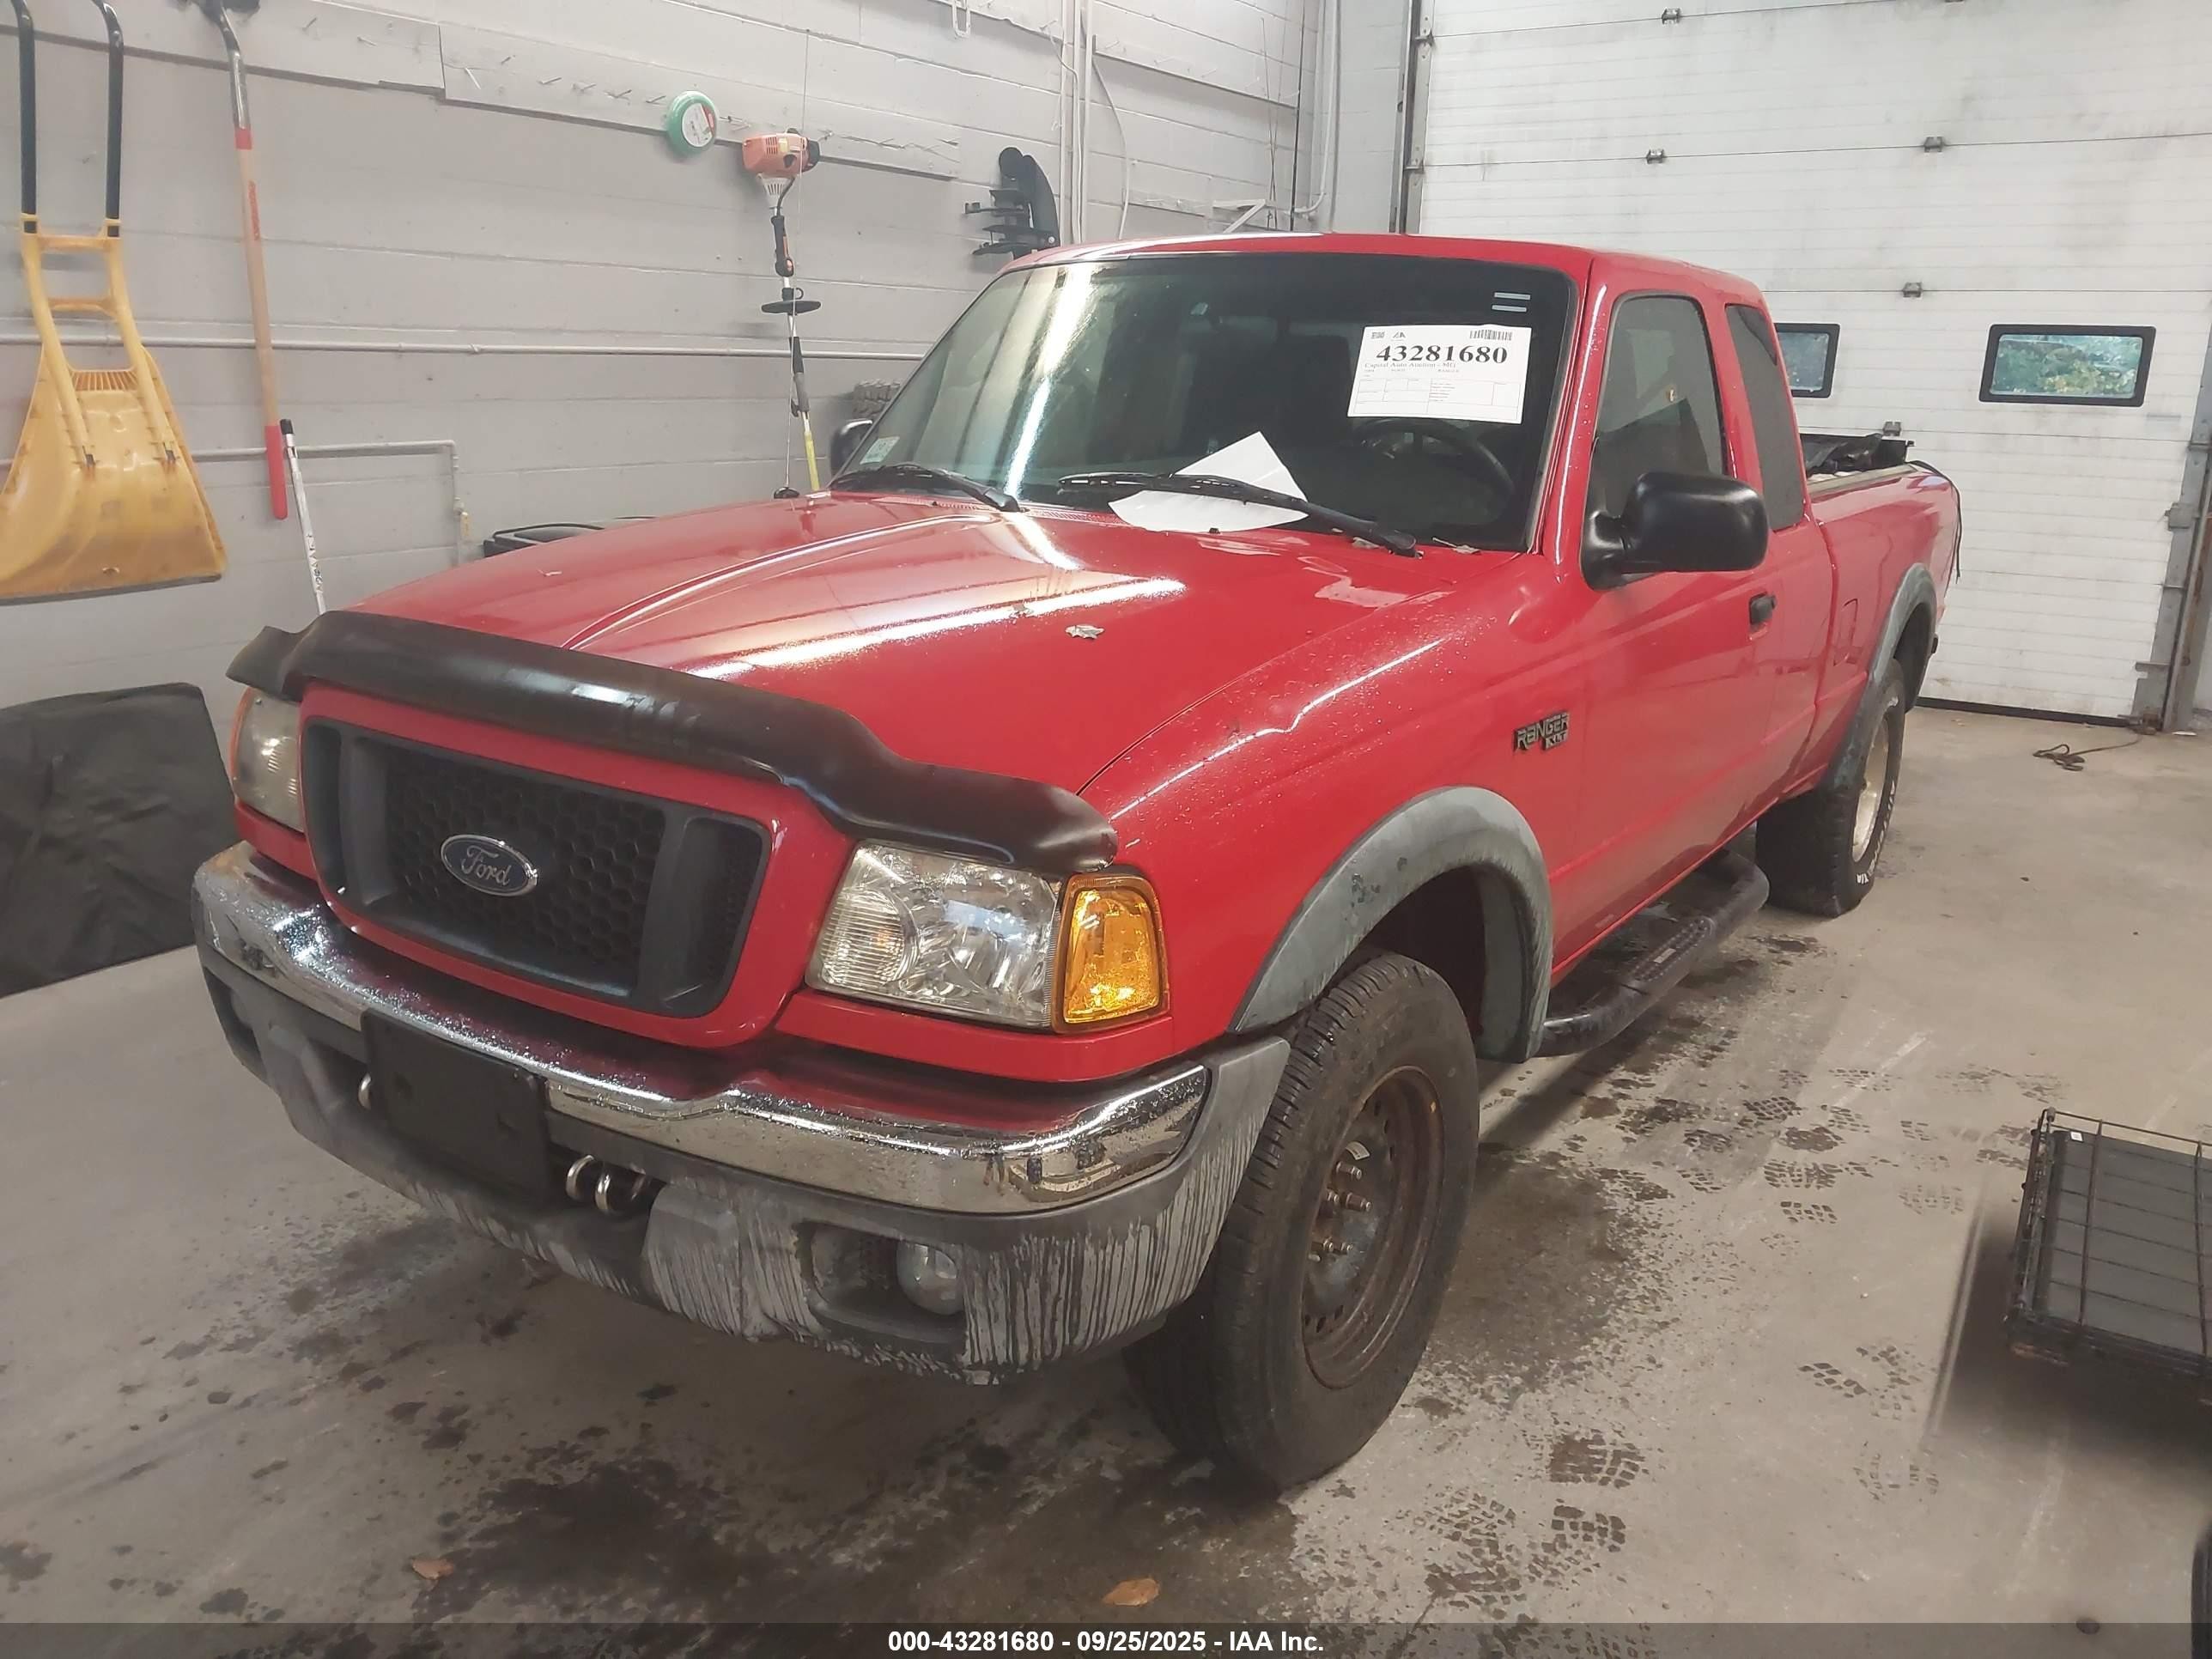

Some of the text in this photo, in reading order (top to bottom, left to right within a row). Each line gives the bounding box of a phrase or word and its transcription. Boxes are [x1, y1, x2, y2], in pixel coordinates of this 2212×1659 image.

[1376, 344, 1508, 364] 43281680
[1514, 711, 1570, 751] RANGER
[460, 844, 512, 886] Ford
